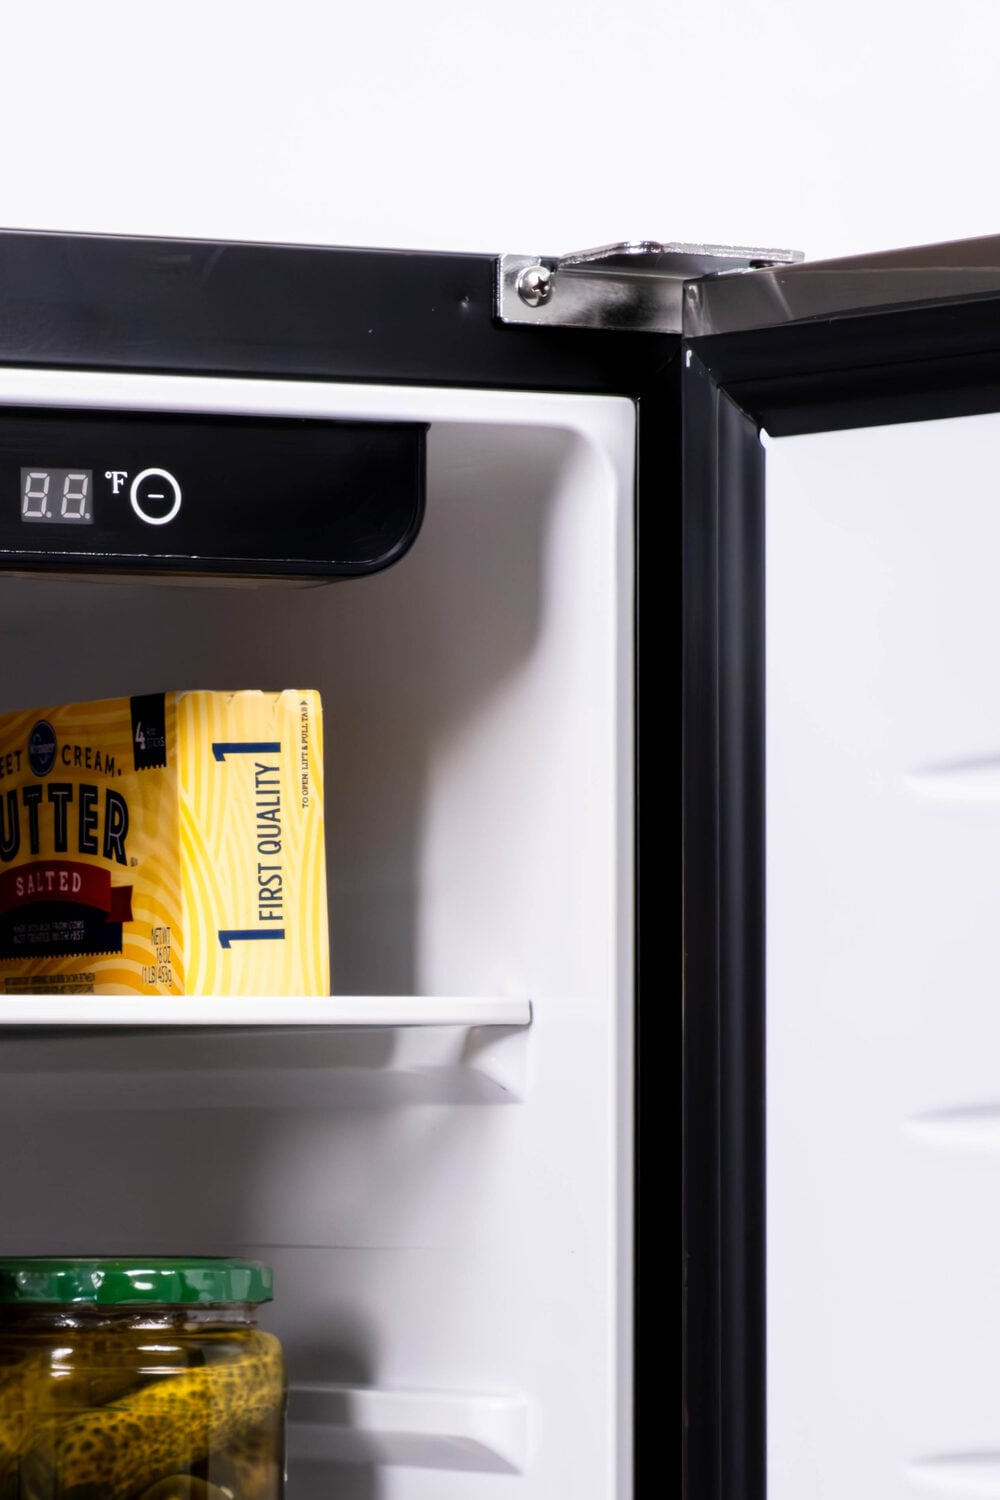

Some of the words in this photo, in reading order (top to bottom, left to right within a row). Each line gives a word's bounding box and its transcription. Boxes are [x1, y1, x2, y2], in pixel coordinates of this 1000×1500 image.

[135, 721, 147, 750] 4
[301, 723, 309, 744] PULL
[61, 744, 116, 777] CREAM
[212, 742, 281, 762] 1
[301, 752, 309, 770] LIFT
[255, 762, 282, 855] QUALITY
[302, 797, 309, 809] TO
[15, 871, 82, 897] SALTED
[258, 862, 284, 921] FIRST
[218, 928, 286, 949] 1
